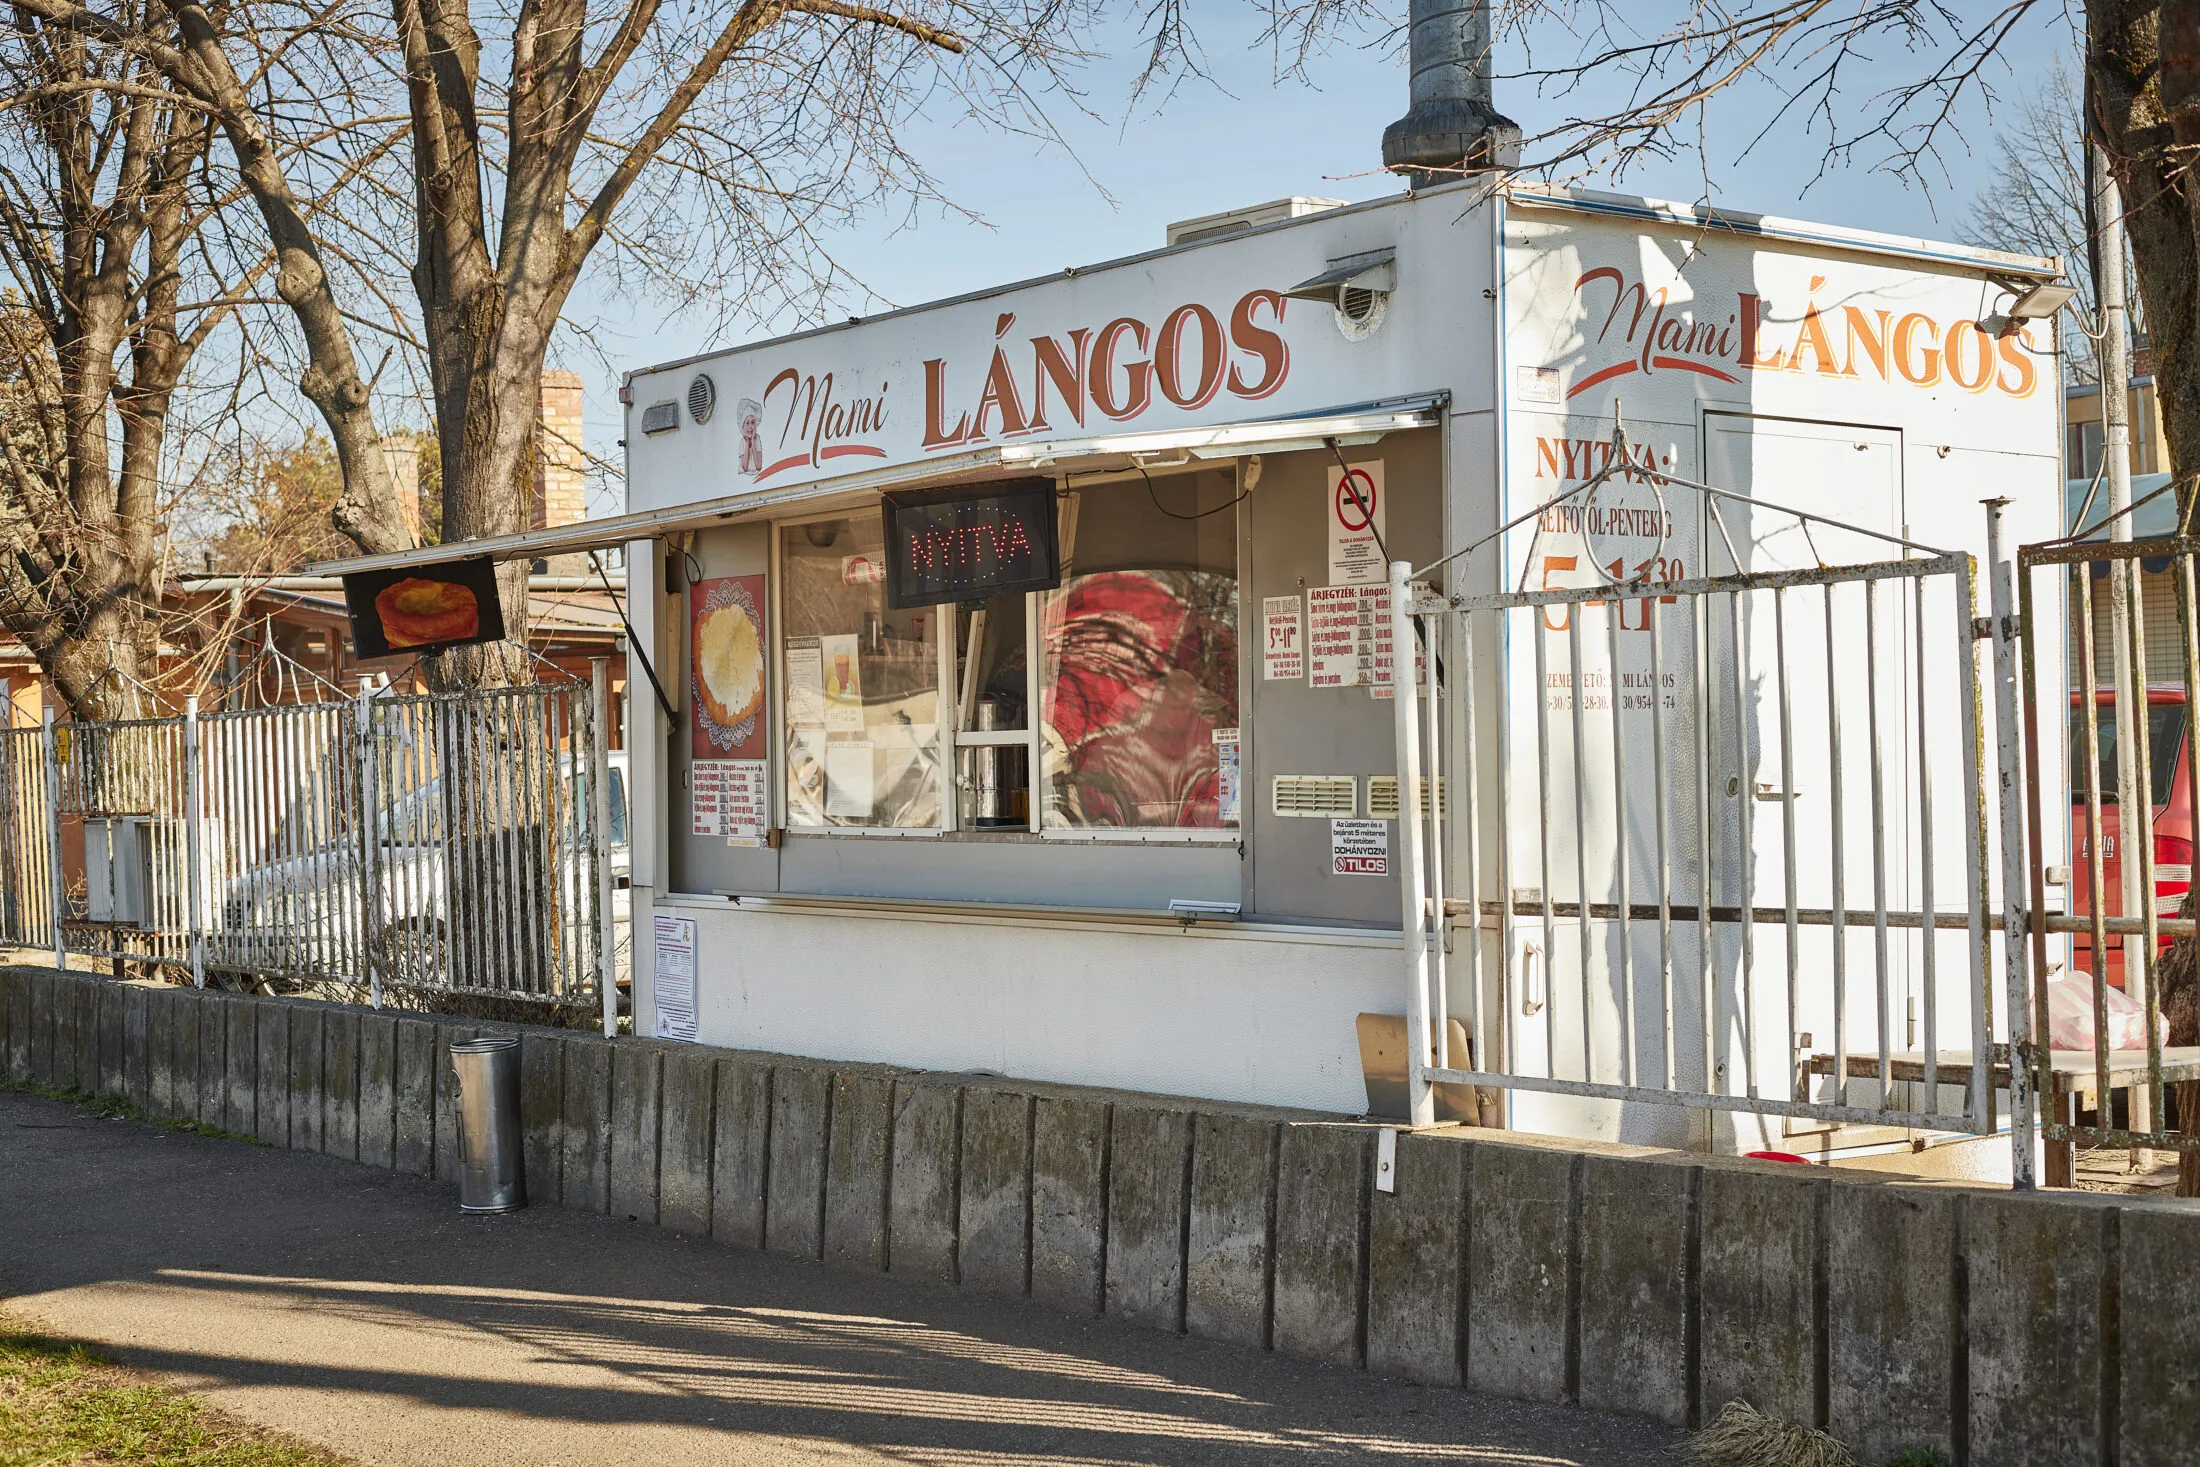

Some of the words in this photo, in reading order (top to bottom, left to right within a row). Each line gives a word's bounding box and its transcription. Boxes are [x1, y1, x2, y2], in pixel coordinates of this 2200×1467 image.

[1574, 266, 1737, 375] Mami
[1736, 274, 2038, 399] LÁNGOS
[763, 367, 890, 469] Mami
[921, 288, 1291, 452] LÁNGOS
[1535, 436, 1670, 487] NYITVA:
[911, 521, 1032, 571] NYITVA
[1310, 586, 1357, 600] ÁRJEGYZÉK:
[1360, 587, 1387, 598] Lángos
[1345, 820, 1370, 828] üzletben
[1333, 829, 1354, 837] bejárat
[1343, 837, 1376, 845] körzetében
[1334, 844, 1387, 856] DOHÁNYOZNI
[1346, 858, 1386, 872] TILOS
